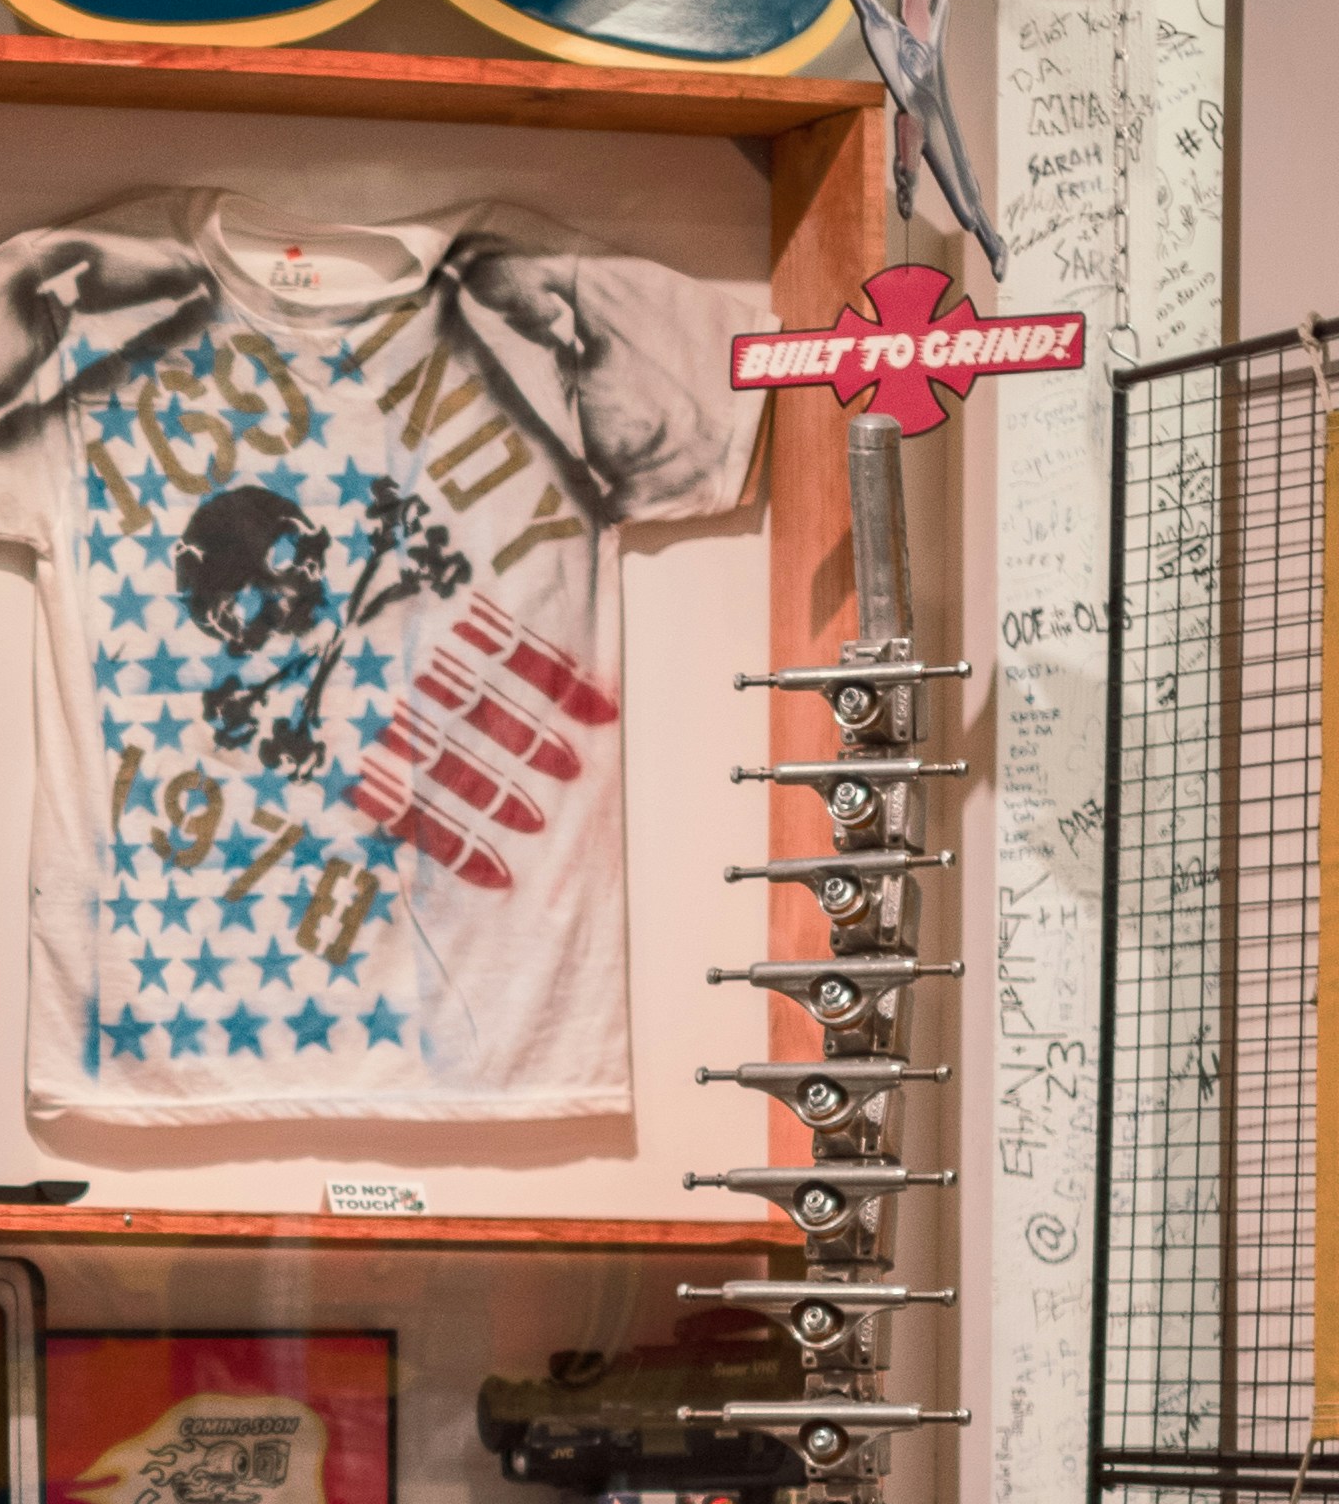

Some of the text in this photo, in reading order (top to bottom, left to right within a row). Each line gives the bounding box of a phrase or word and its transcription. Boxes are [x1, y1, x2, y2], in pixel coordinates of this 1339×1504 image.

[737, 322, 1081, 381] BUILT TO GRIND!
[87, 334, 311, 535] 169
[331, 1183, 398, 1197] DO NOT
[334, 1199, 397, 1212] TOUCH
[550, 1447, 575, 1460] JVC
